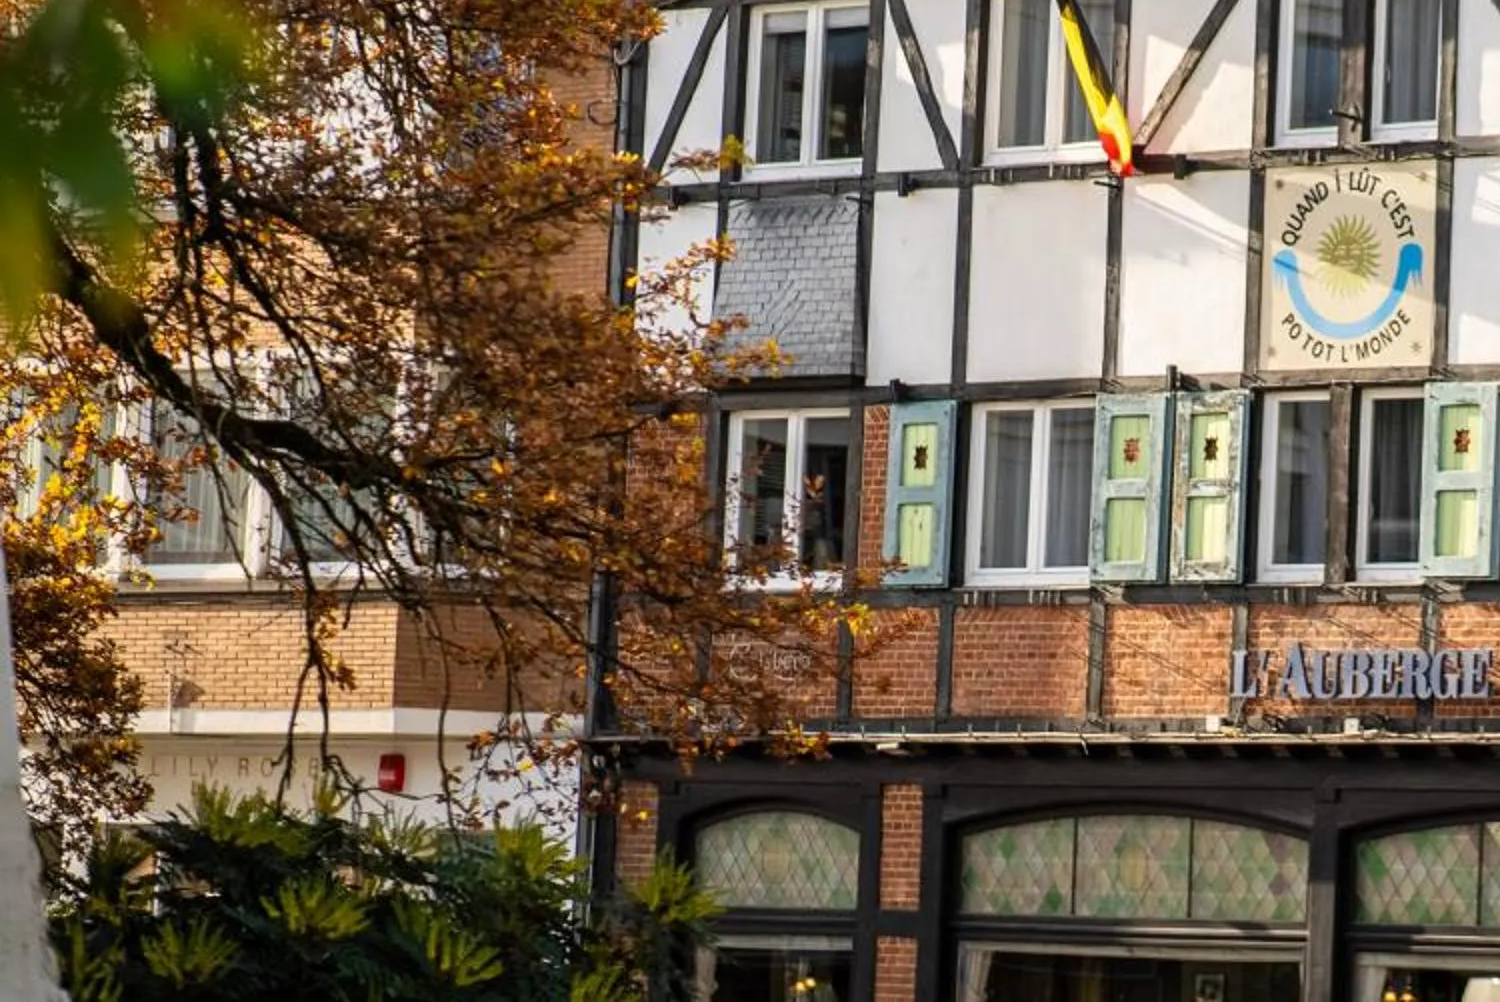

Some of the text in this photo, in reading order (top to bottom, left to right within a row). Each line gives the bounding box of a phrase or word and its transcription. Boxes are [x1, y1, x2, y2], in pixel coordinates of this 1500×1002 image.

[1281, 181, 1329, 246] QUAND
[1381, 189, 1415, 239] C'EST
[1340, 309, 1411, 363] L'MONDE
[1230, 640, 1493, 699] L'AUBERGE
[149, 757, 219, 777] LILY
